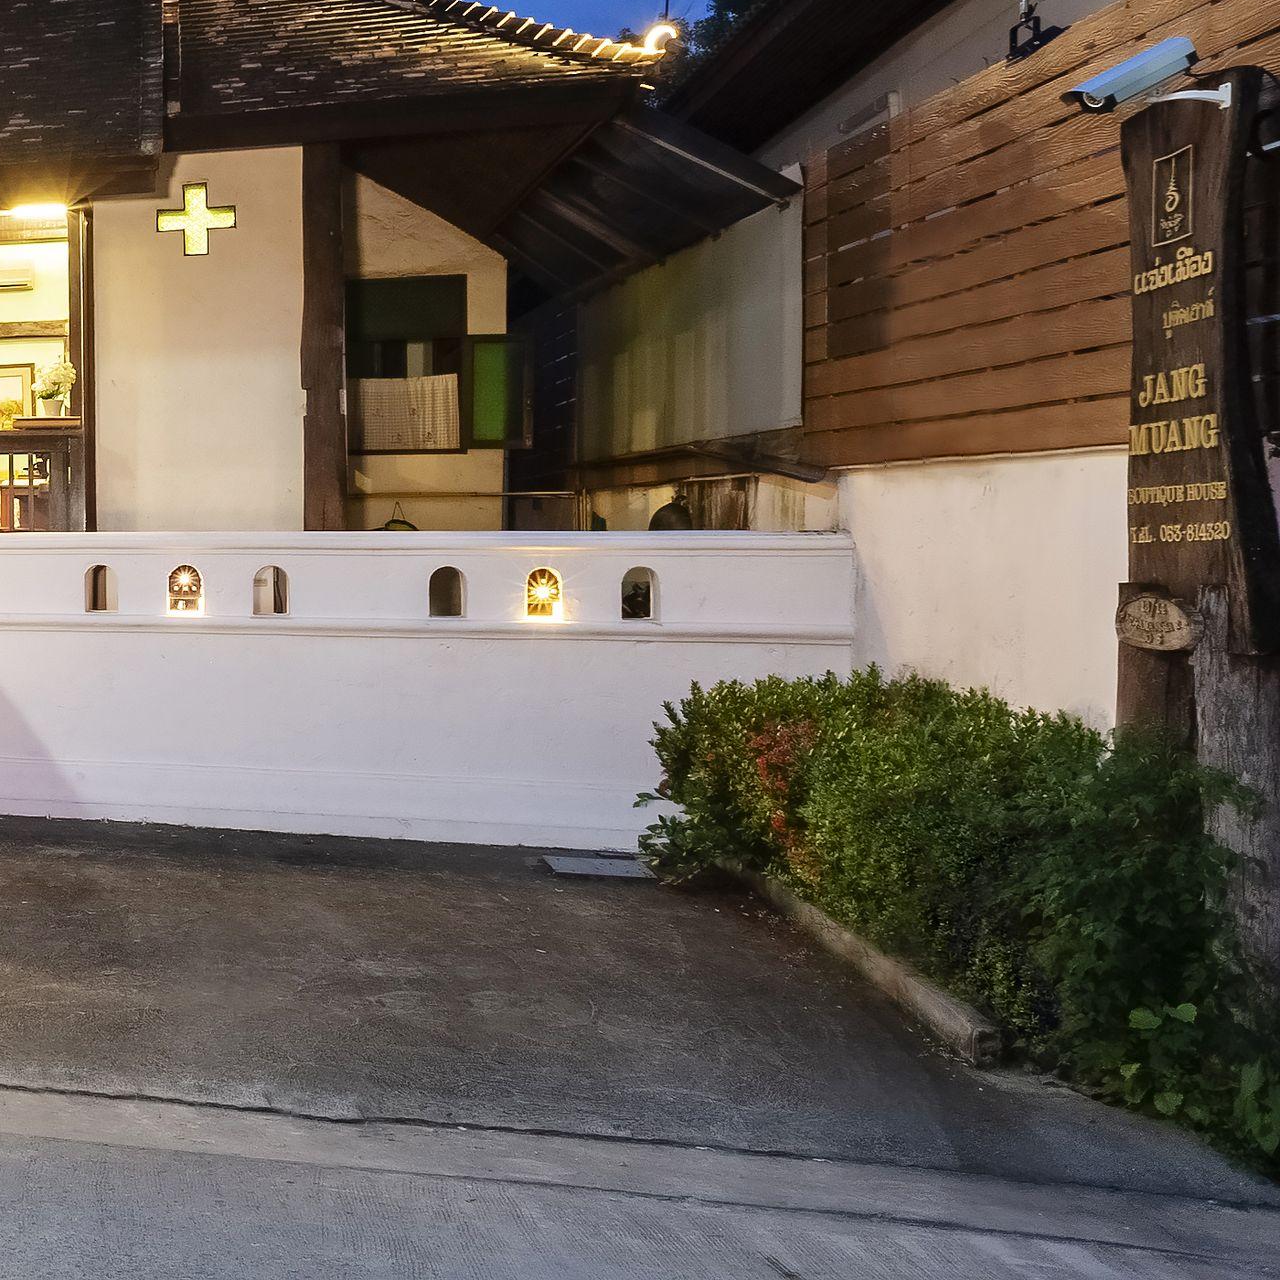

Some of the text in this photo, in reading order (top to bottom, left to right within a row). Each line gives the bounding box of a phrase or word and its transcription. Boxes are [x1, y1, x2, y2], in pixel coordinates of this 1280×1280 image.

[1138, 363, 1208, 407] JANG
[1128, 413, 1220, 456] MUANG
[1128, 481, 1227, 507] BOUTIQUE HOUSE
